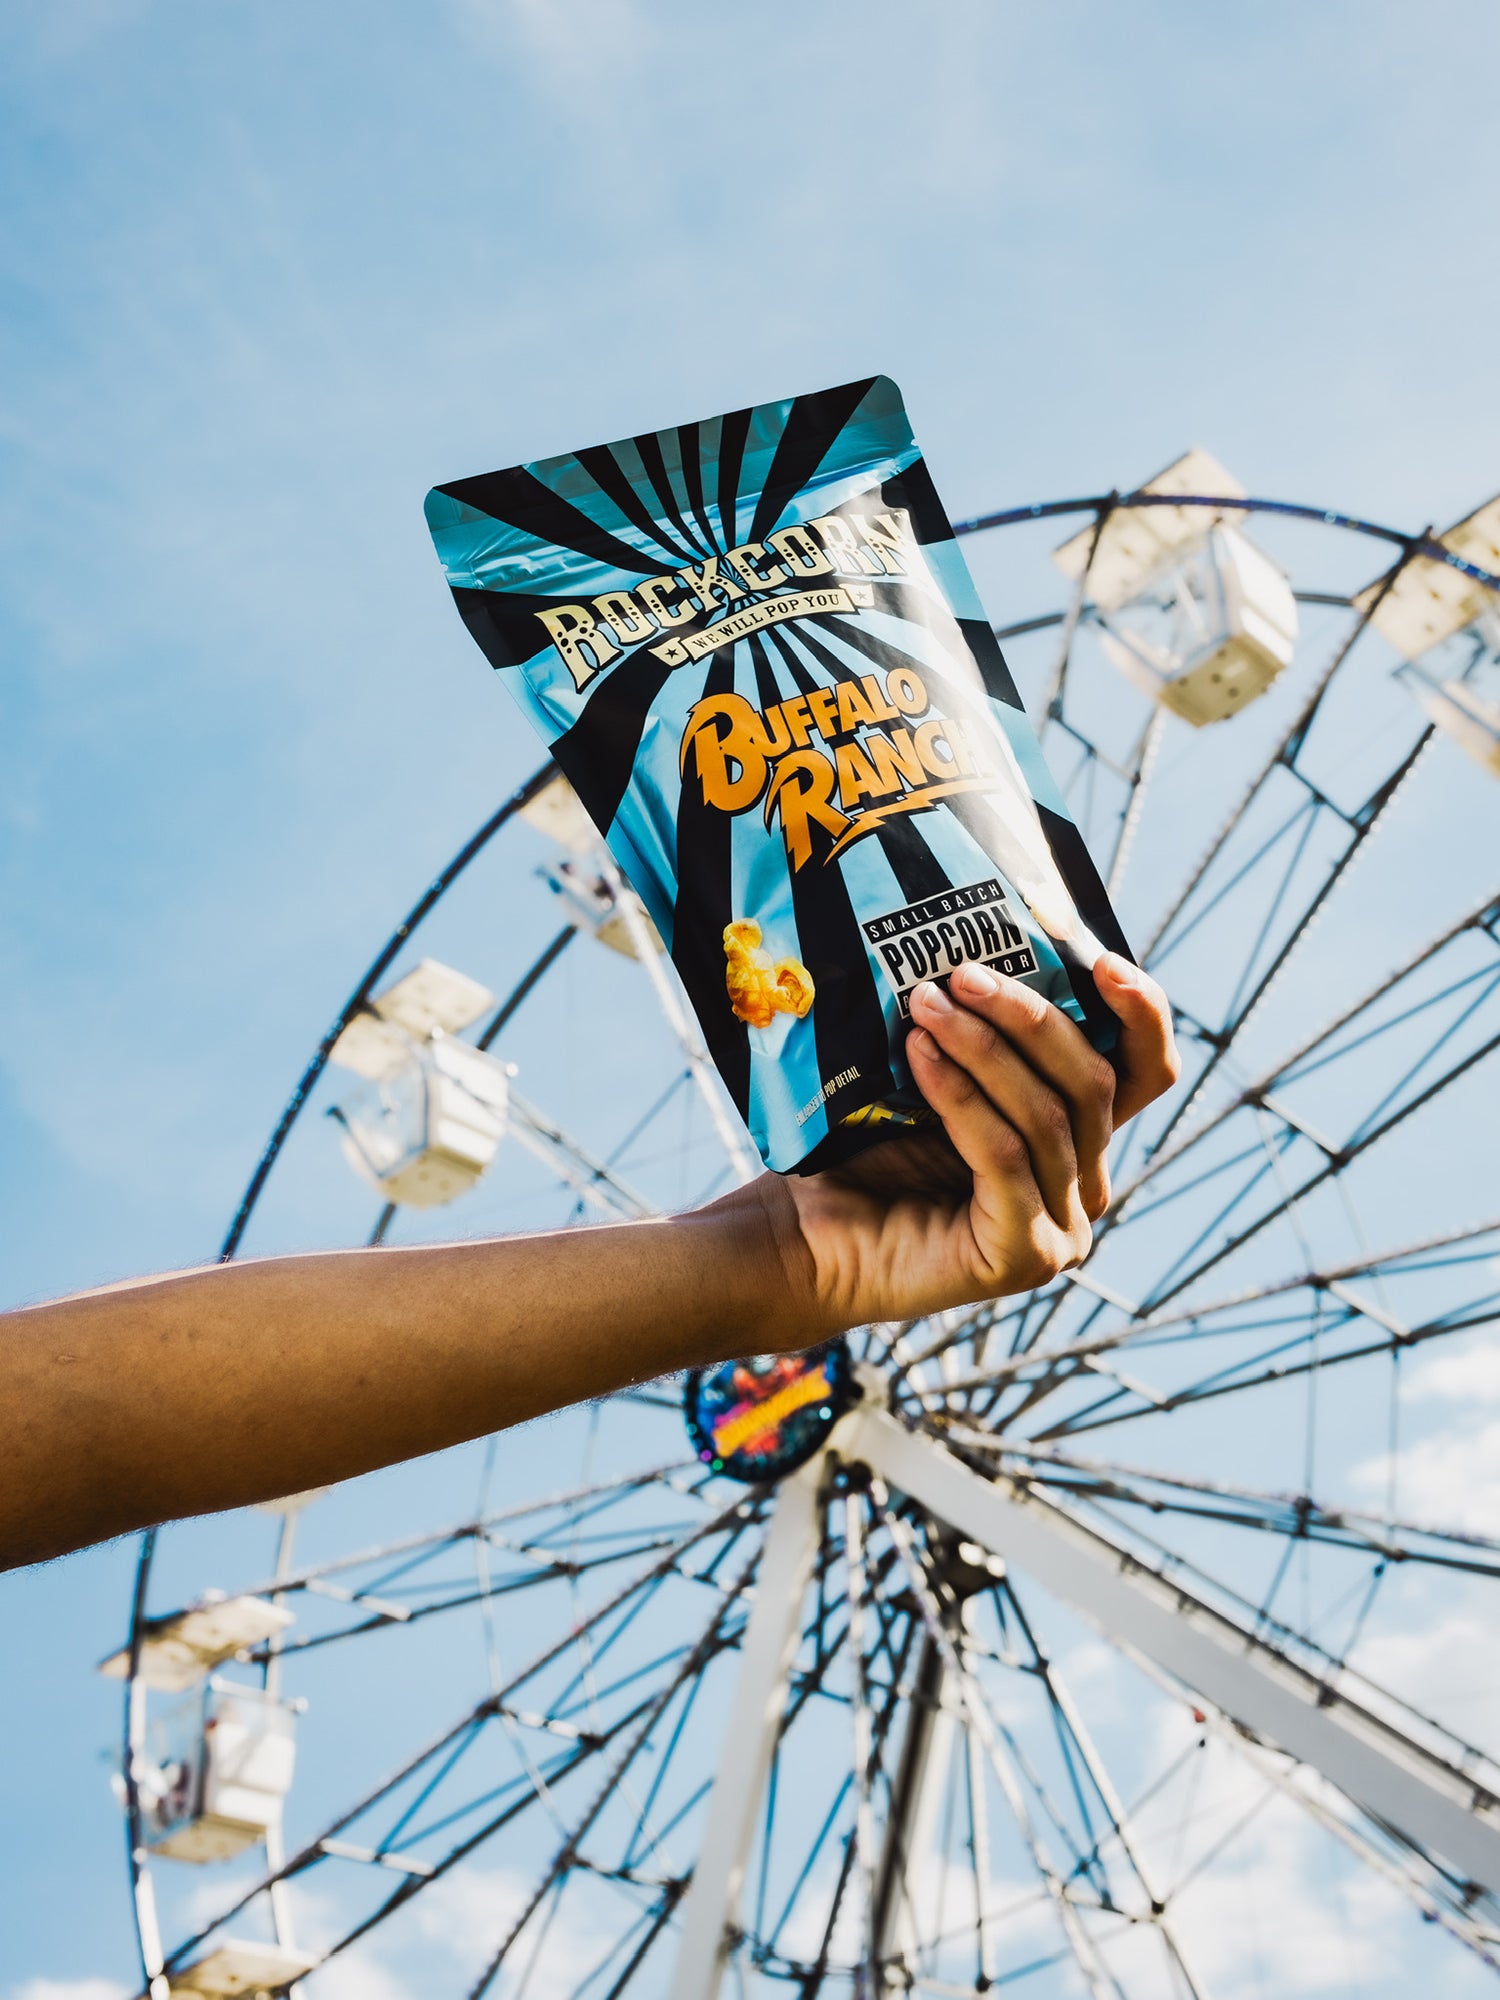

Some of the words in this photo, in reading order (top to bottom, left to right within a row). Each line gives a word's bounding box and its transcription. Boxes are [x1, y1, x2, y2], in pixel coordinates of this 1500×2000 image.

[533, 513, 911, 690] ROCKCORN
[692, 634, 720, 650] WE
[718, 613, 764, 638] WILL
[765, 599, 800, 618] POP
[803, 594, 840, 609] YOU
[680, 667, 929, 812] BUFFALO
[764, 719, 991, 874] RANCH
[869, 906, 934, 939] SMALL
[940, 884, 1001, 912] BATCH
[879, 903, 1024, 987] POPCORN
[824, 1080, 837, 1098] POP
[835, 1065, 862, 1089] DETAIL
